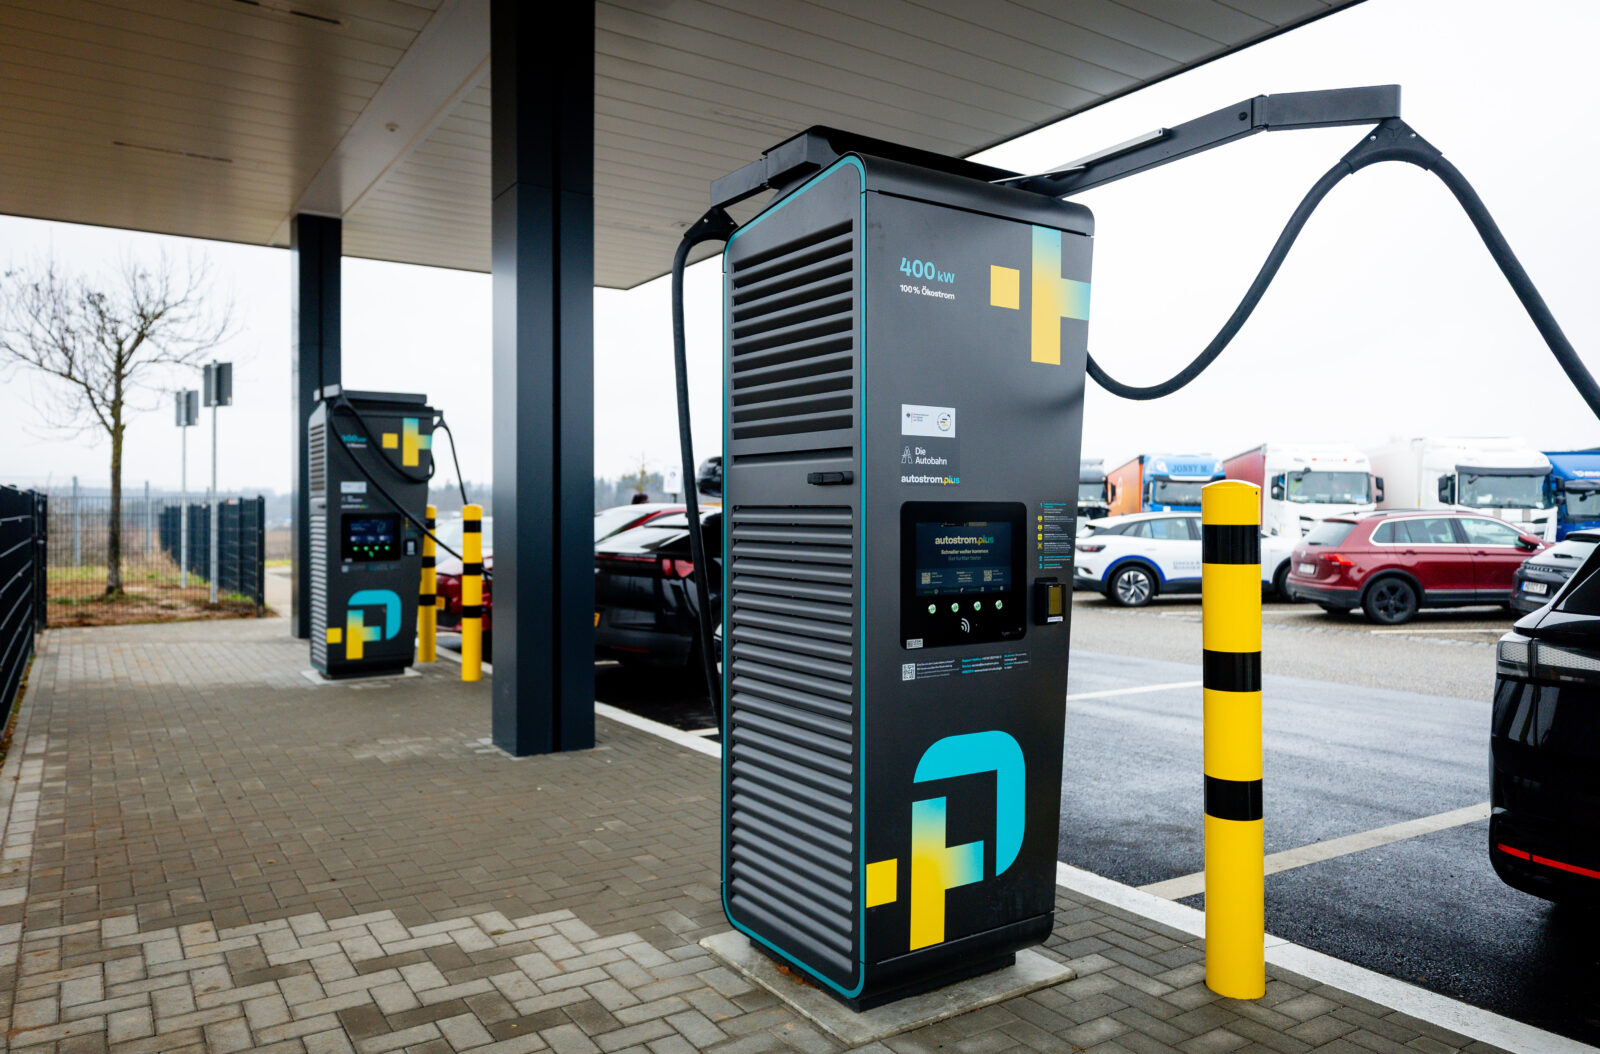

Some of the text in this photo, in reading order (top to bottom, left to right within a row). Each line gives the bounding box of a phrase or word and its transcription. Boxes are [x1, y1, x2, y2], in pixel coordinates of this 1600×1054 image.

[900, 257, 955, 284] 400 kW
[921, 285, 955, 300] Ökostrom
[915, 446, 926, 456] Die
[915, 456, 948, 466] Autobahn
[901, 474, 960, 486] autostrom.plus
[935, 534, 994, 546] autostrom.plus
